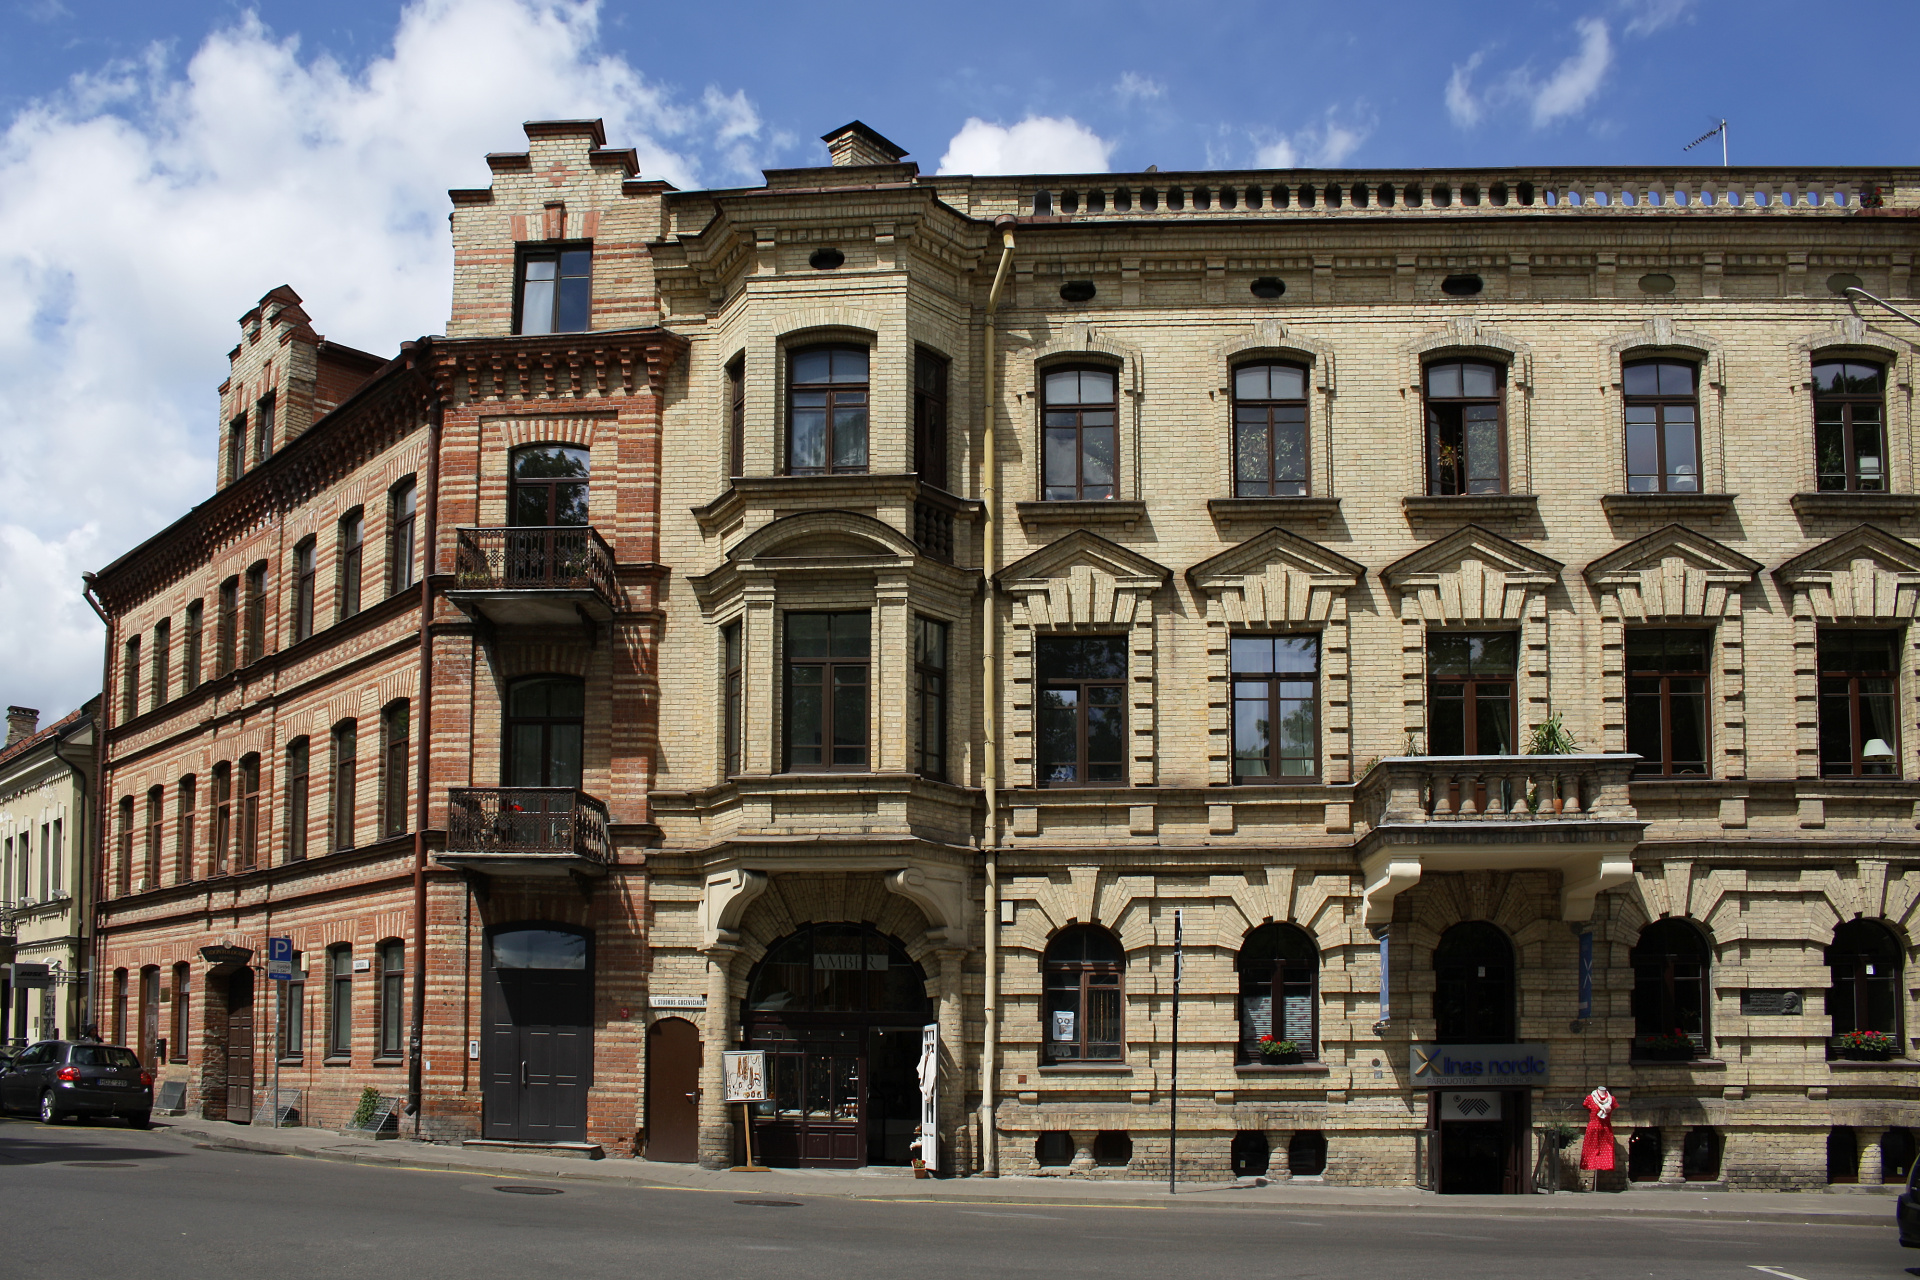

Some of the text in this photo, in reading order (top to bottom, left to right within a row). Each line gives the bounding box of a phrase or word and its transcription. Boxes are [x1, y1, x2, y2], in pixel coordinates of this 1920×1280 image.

[275, 940, 288, 959] P
[814, 955, 878, 970] AMBER
[1444, 1055, 1546, 1075] linas nordic
[1487, 1077, 1510, 1085] LINEN
[1511, 1076, 1533, 1085] SHOP
